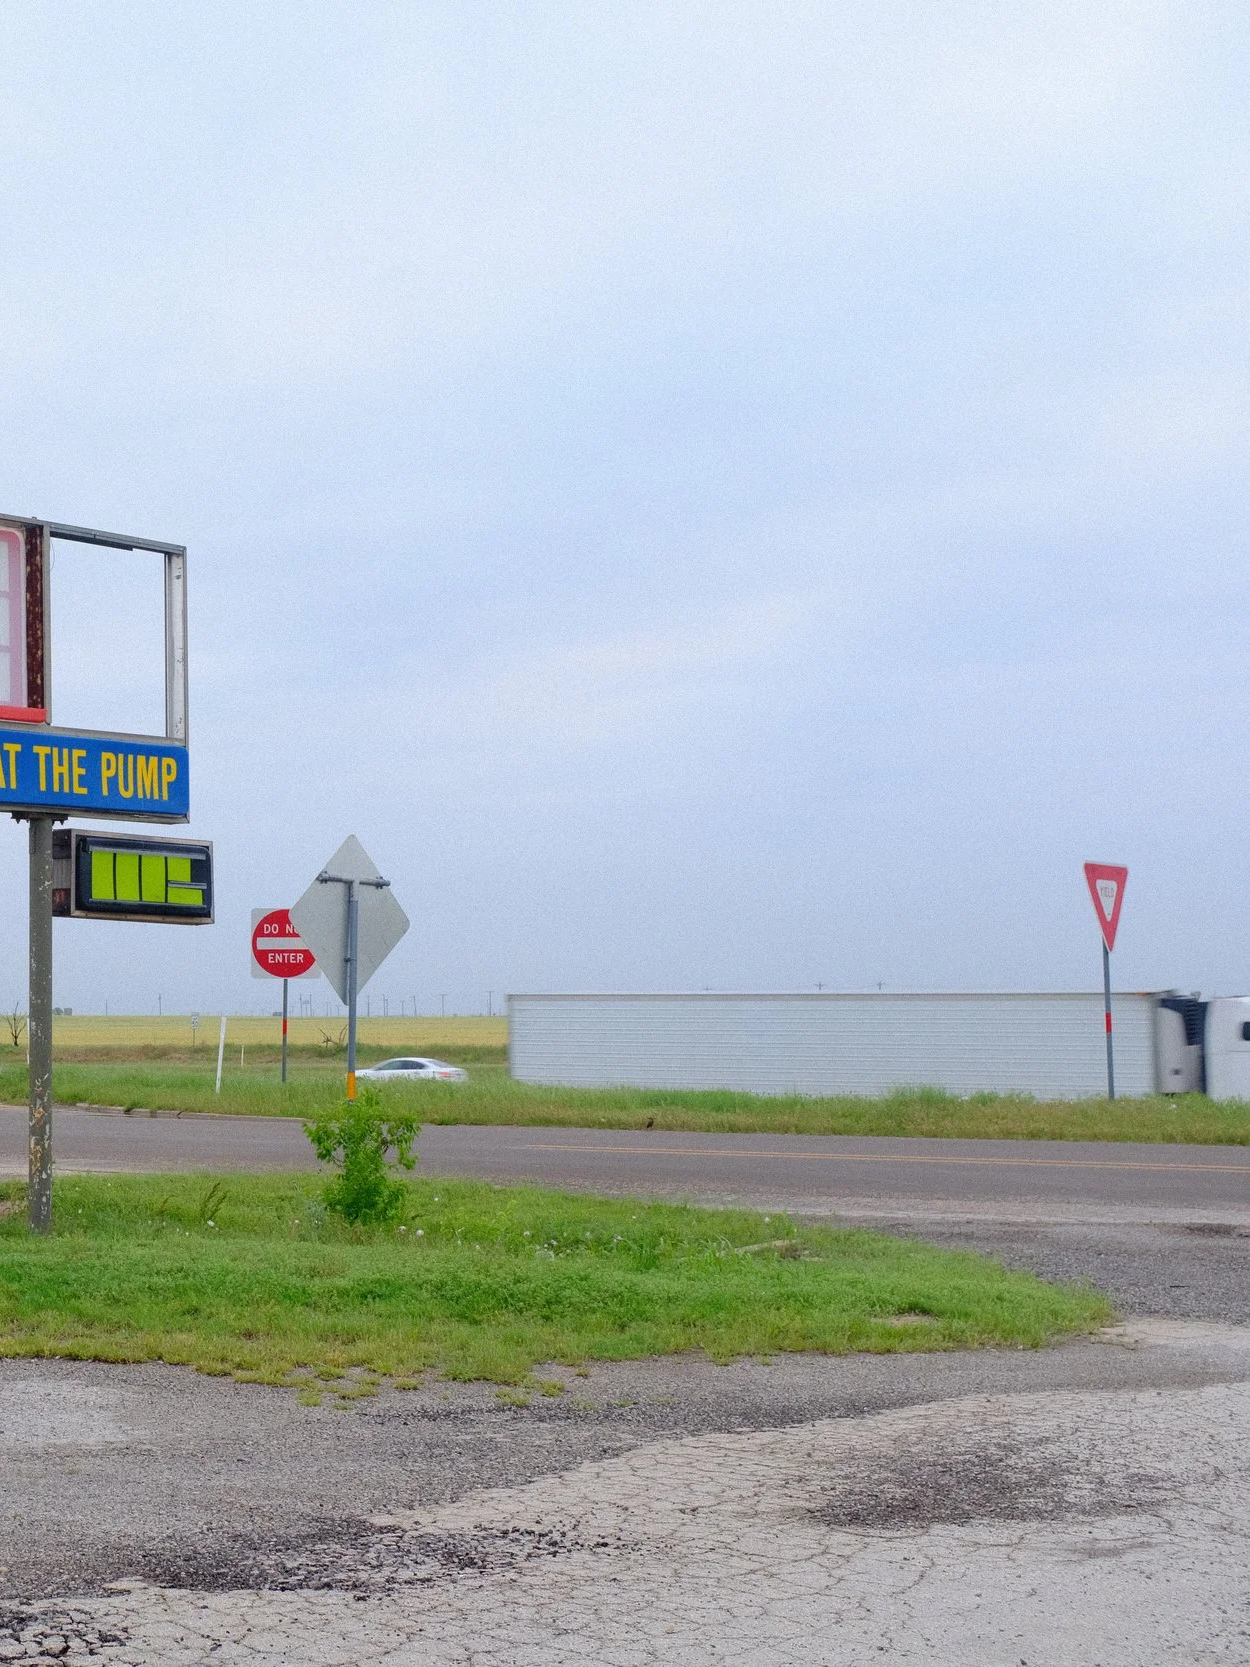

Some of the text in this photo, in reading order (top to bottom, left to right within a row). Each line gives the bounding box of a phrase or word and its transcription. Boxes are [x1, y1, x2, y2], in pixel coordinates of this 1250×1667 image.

[32, 745, 88, 795] THE
[101, 752, 178, 801] PUMP
[263, 923, 279, 934] DO
[268, 953, 304, 964] ENTER
